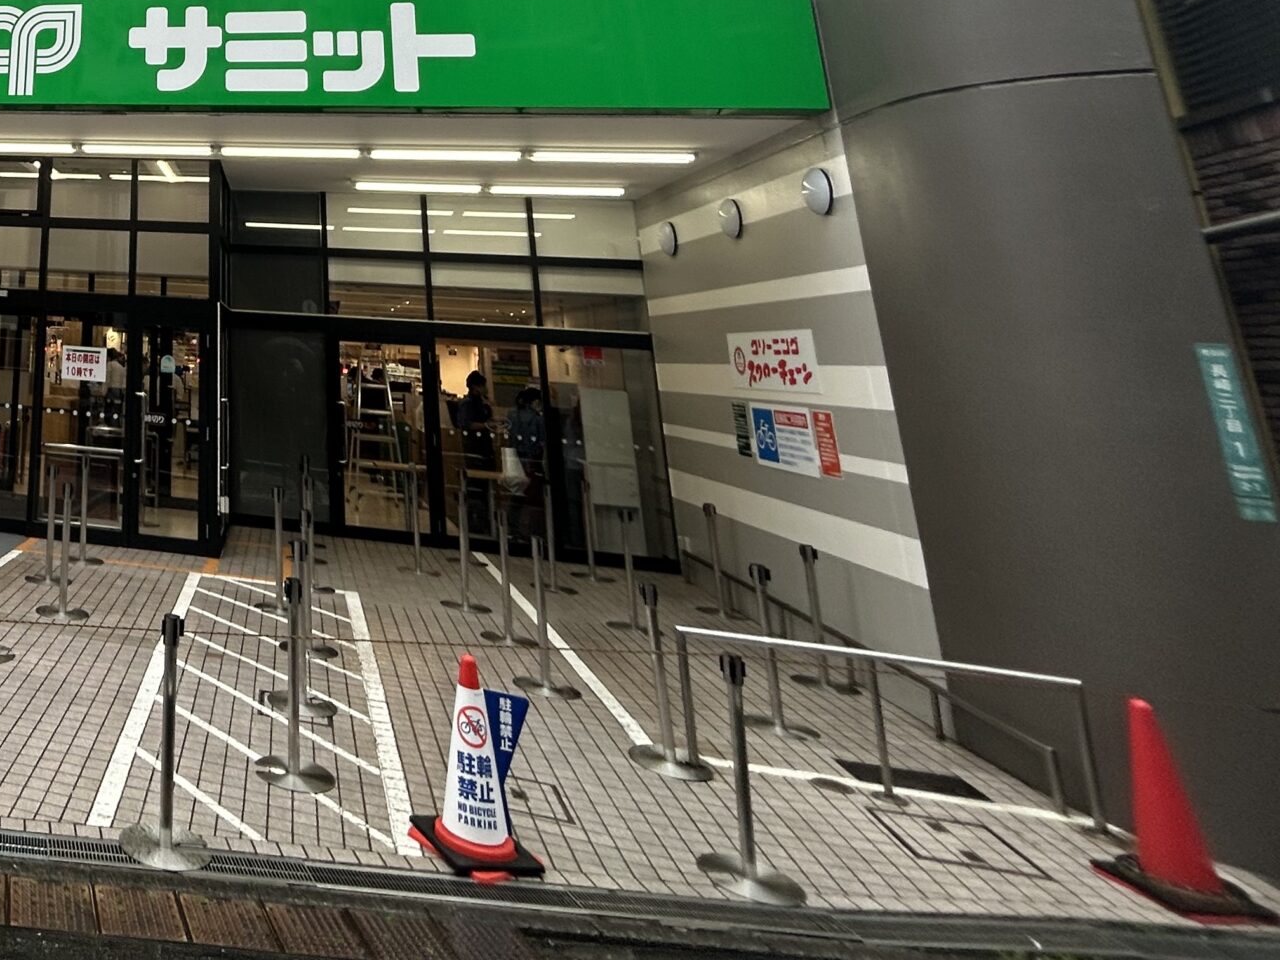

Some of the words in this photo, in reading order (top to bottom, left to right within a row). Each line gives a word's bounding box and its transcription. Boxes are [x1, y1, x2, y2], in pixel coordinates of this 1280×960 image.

[128, 2, 477, 93] サミット
[751, 337, 799, 355] クリーニング
[499, 697, 512, 752] 駐輪禁止
[457, 750, 492, 778] 駐輪
[458, 776, 495, 803] 禁止
[457, 801, 467, 812] NO
[469, 804, 496, 818] BICYCLE
[458, 813, 497, 830] PARKING
